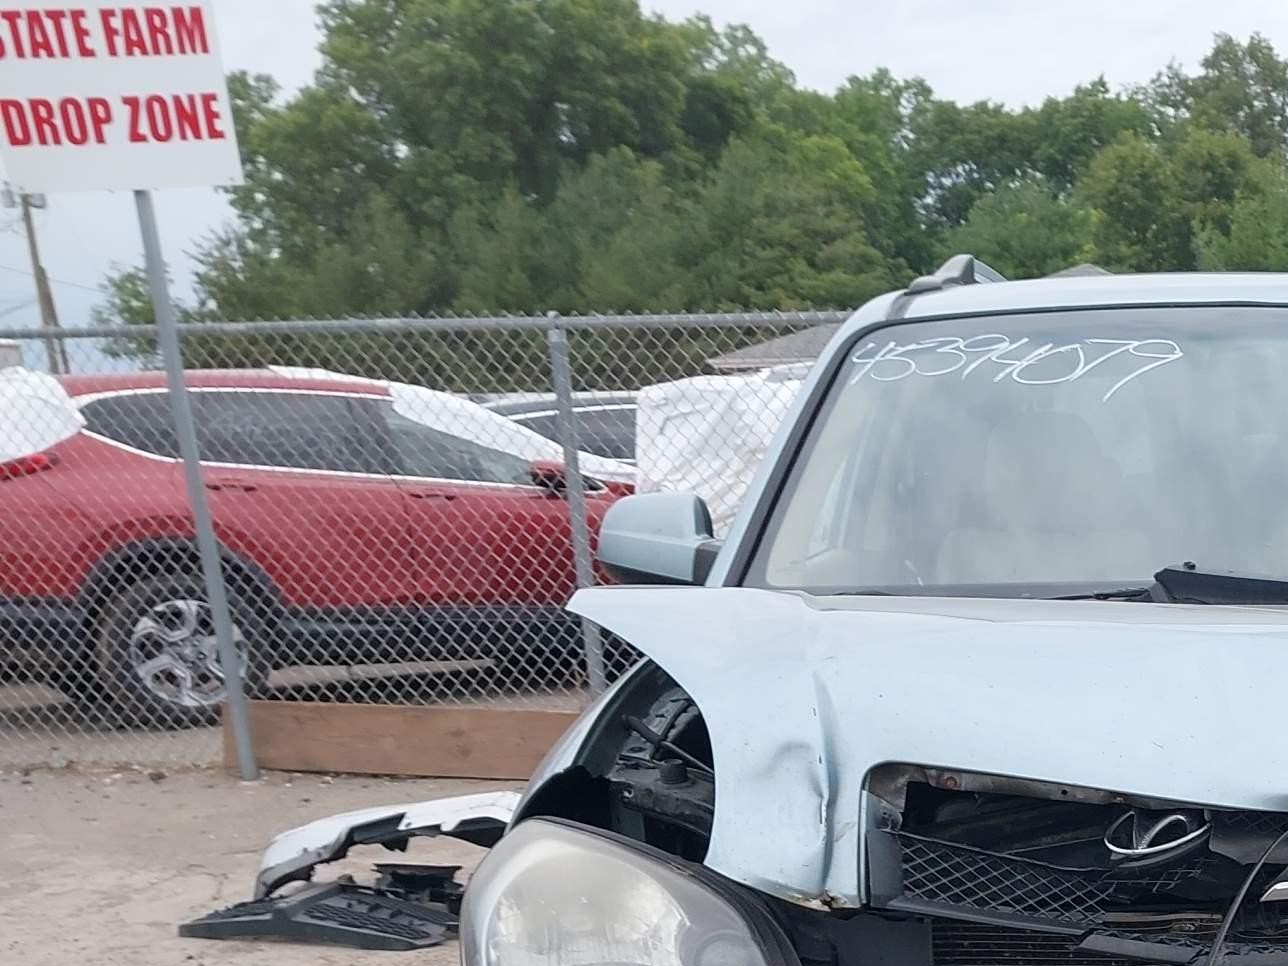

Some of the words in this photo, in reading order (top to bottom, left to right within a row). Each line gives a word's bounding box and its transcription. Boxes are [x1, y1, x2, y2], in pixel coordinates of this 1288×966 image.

[0, 9, 96, 59] TATE
[99, 6, 209, 57] FARM
[0, 97, 113, 146] DROP
[121, 93, 225, 143] ZONE
[851, 333, 1184, 403] 45394079
